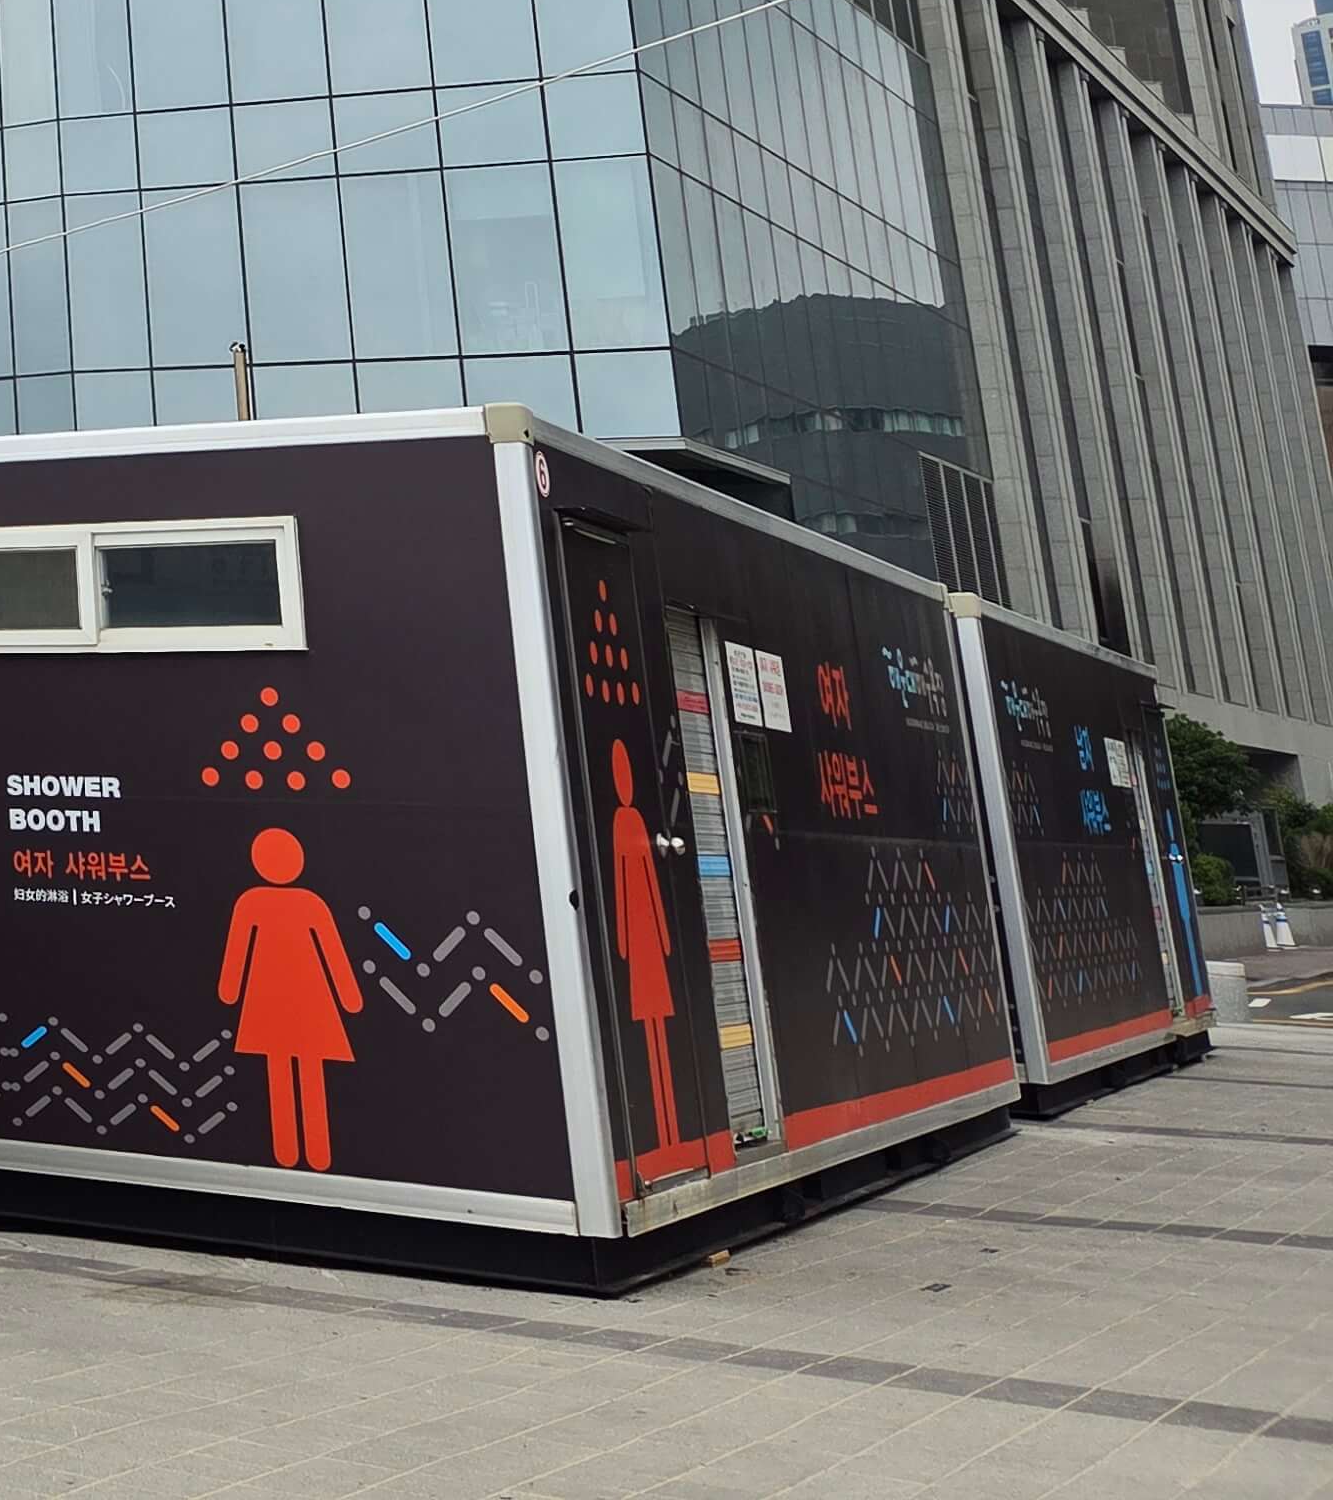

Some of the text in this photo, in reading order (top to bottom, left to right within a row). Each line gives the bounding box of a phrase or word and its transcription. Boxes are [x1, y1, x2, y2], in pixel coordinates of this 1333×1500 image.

[816, 660, 853, 732] 여자
[6, 774, 121, 798] SHOWER
[8, 808, 101, 833] BOOTH
[13, 849, 151, 882] 여자 샤워부스
